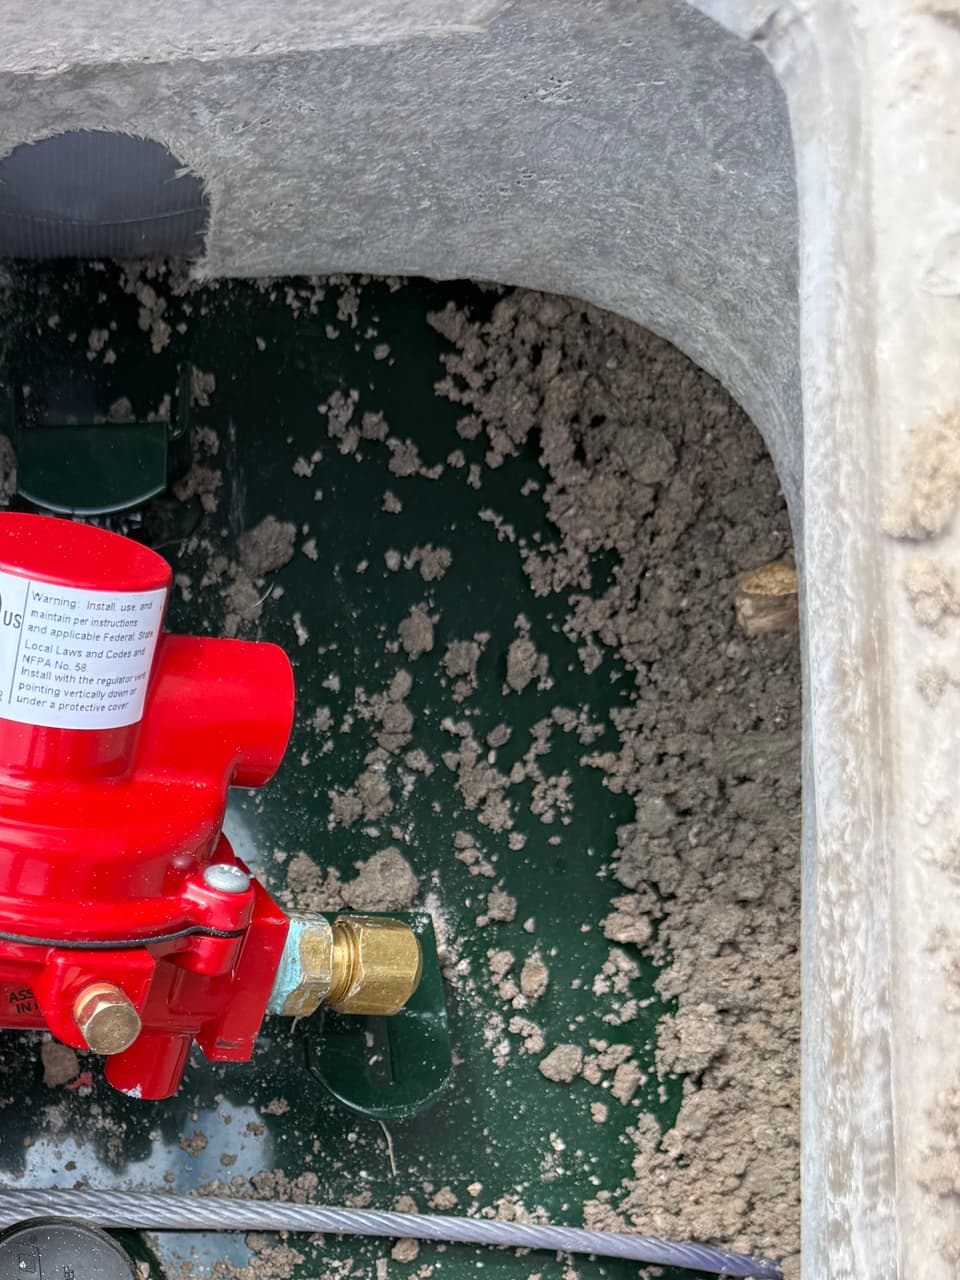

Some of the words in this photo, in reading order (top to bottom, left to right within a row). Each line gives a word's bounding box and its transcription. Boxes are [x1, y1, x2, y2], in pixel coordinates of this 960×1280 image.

[32, 591, 80, 610] Warning:
[3, 610, 22, 629] US
[30, 609, 71, 624] maintain
[73, 617, 89, 627] per
[91, 618, 138, 628] instructions
[27, 623, 48, 634] and
[50, 628, 100, 641] applicable
[24, 640, 54, 653] Local
[55, 646, 82, 658] Laws
[85, 649, 104, 659] and
[105, 650, 131, 660] Codes
[133, 648, 146, 657] and
[22, 654, 51, 667] NFPA
[20, 666, 52, 680] Install
[54, 674, 76, 684] with
[78, 676, 94, 685] the
[96, 675, 133, 687] regulator
[18, 682, 61, 697] pointing
[64, 688, 105, 700] vertically
[108, 690, 129, 699] down
[129, 688, 138, 696] or
[16, 695, 47, 708] under
[58, 702, 105, 713] protective
